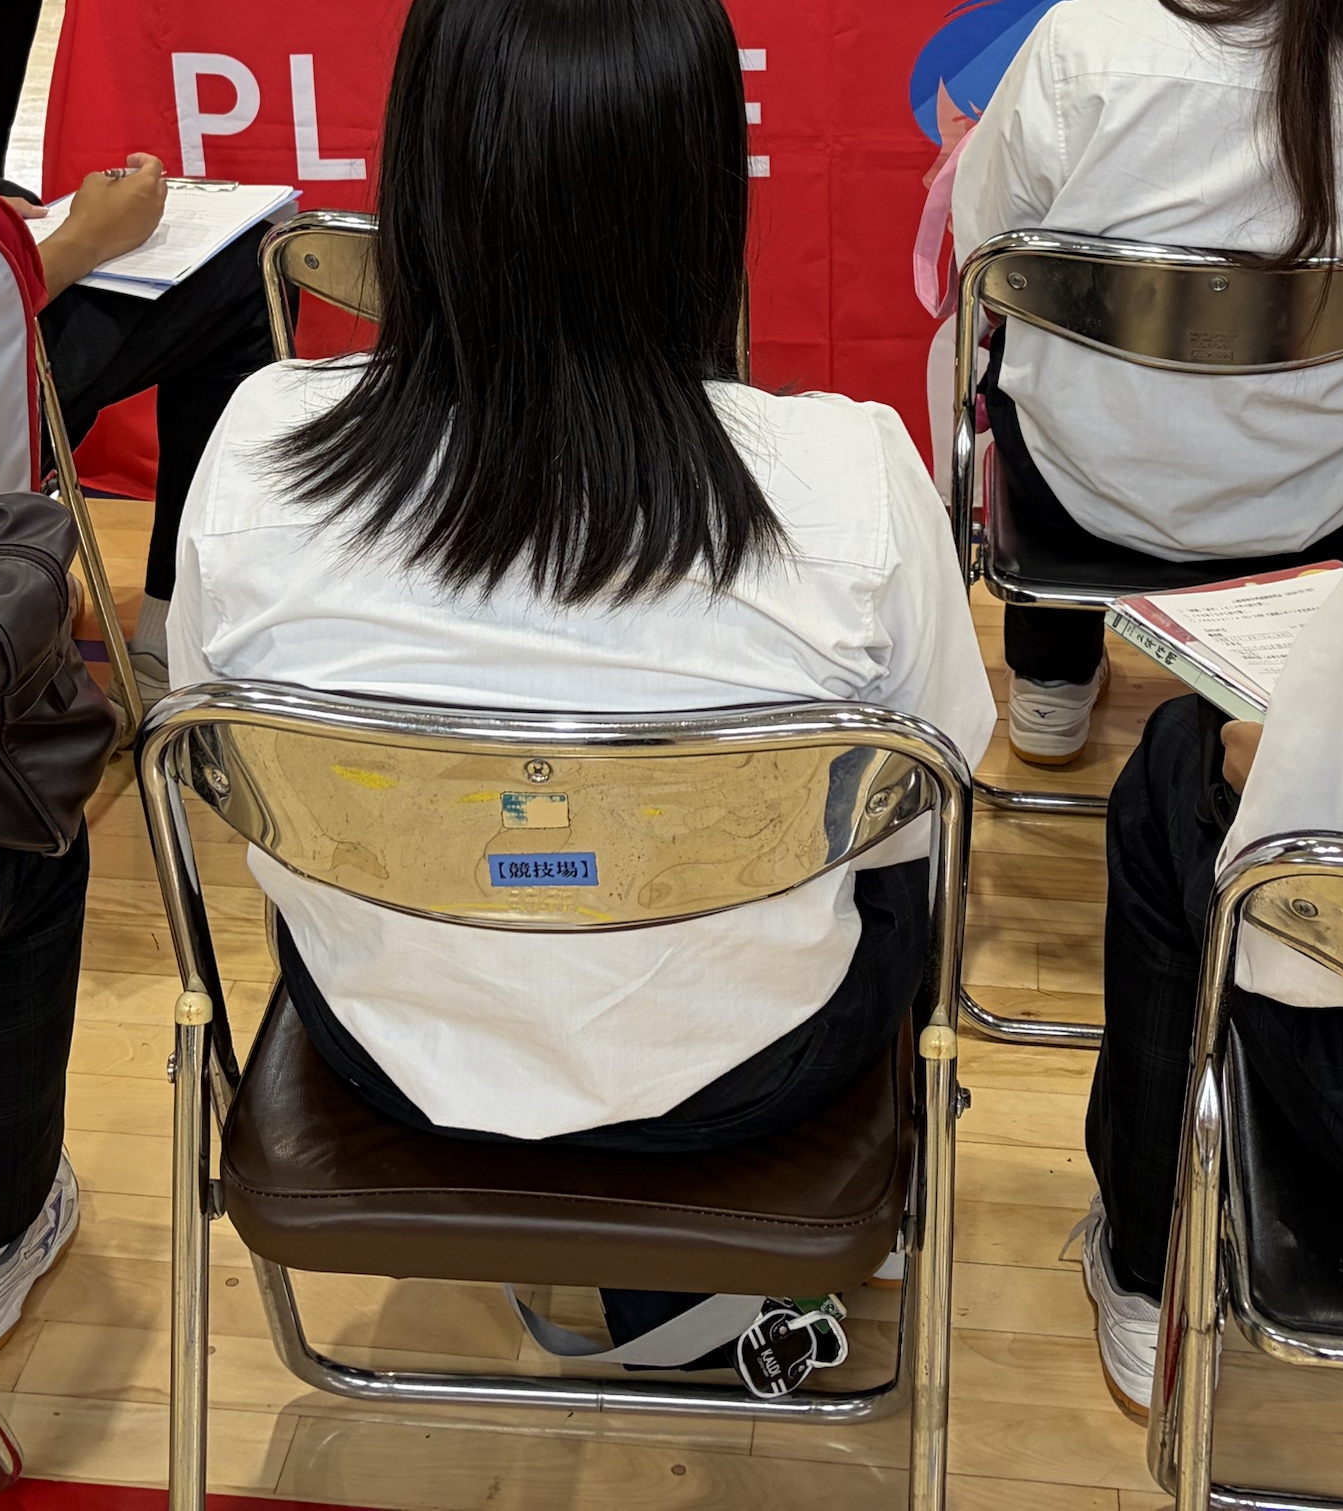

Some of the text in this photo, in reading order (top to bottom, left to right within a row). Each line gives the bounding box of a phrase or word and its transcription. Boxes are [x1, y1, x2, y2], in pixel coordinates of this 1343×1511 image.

[497, 860, 589, 879] 【競技場】
[760, 1348, 782, 1378] KALDI
